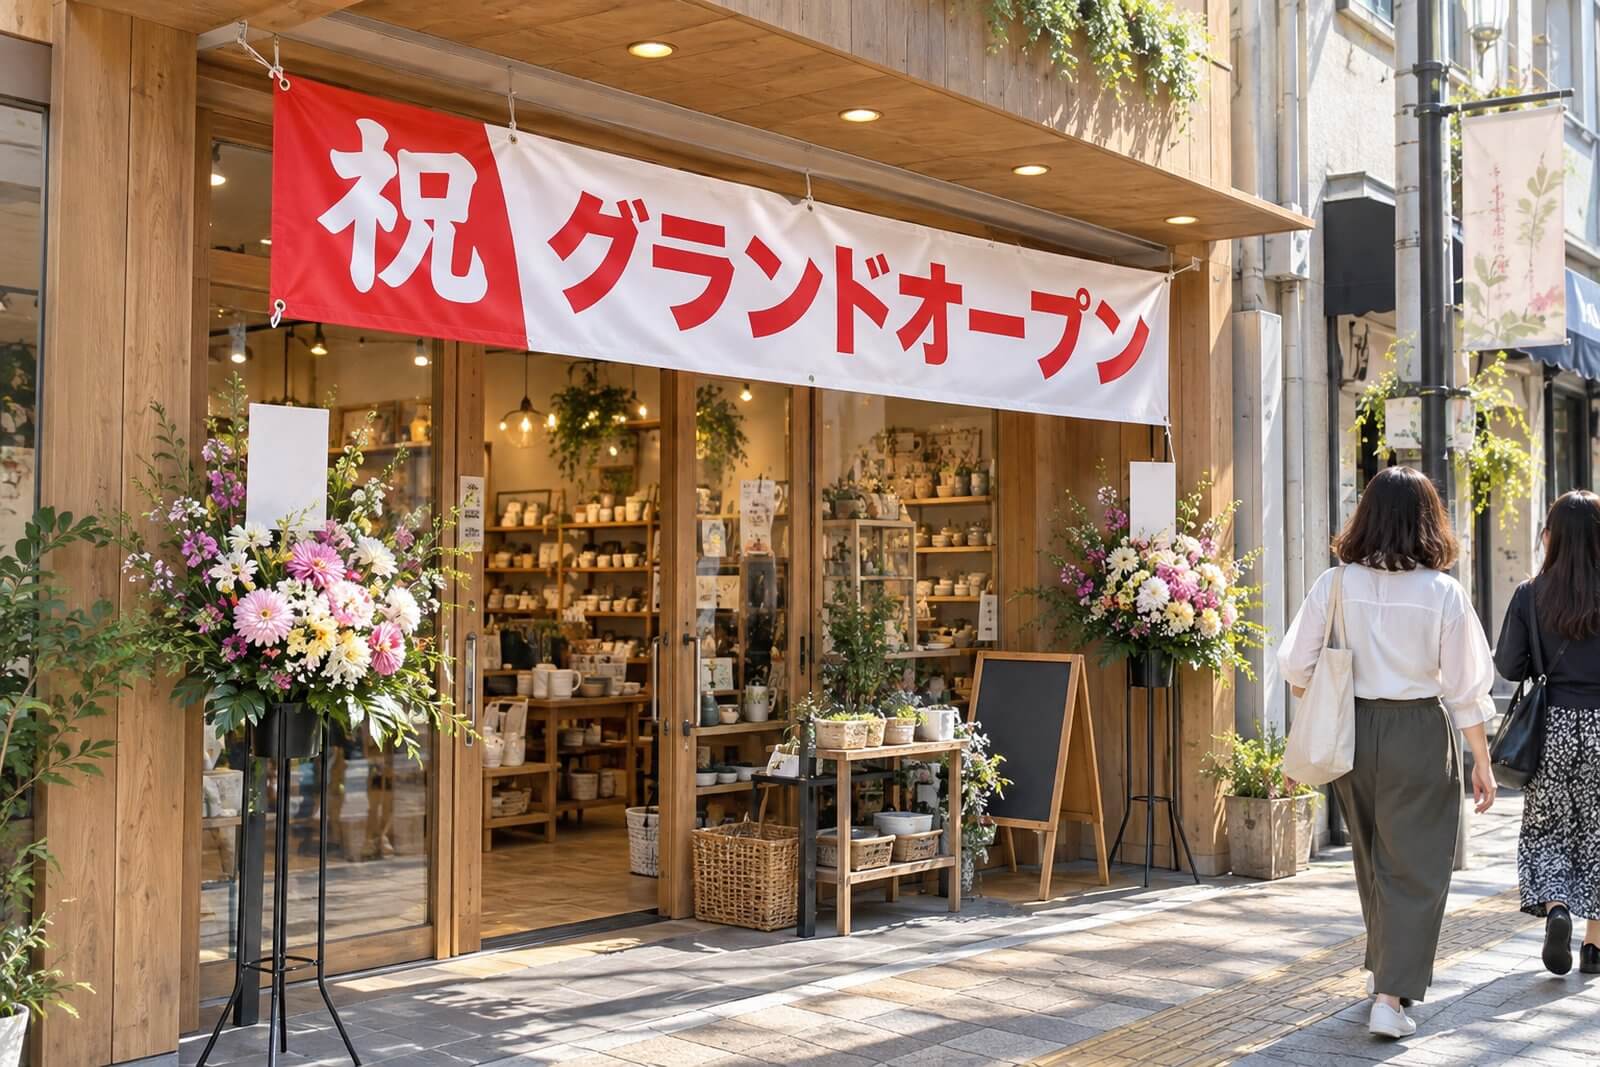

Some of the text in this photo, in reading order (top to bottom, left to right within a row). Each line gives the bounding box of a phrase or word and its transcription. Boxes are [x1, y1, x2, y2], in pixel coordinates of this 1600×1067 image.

[318, 118, 1149, 385] 祝 グランドオープン
